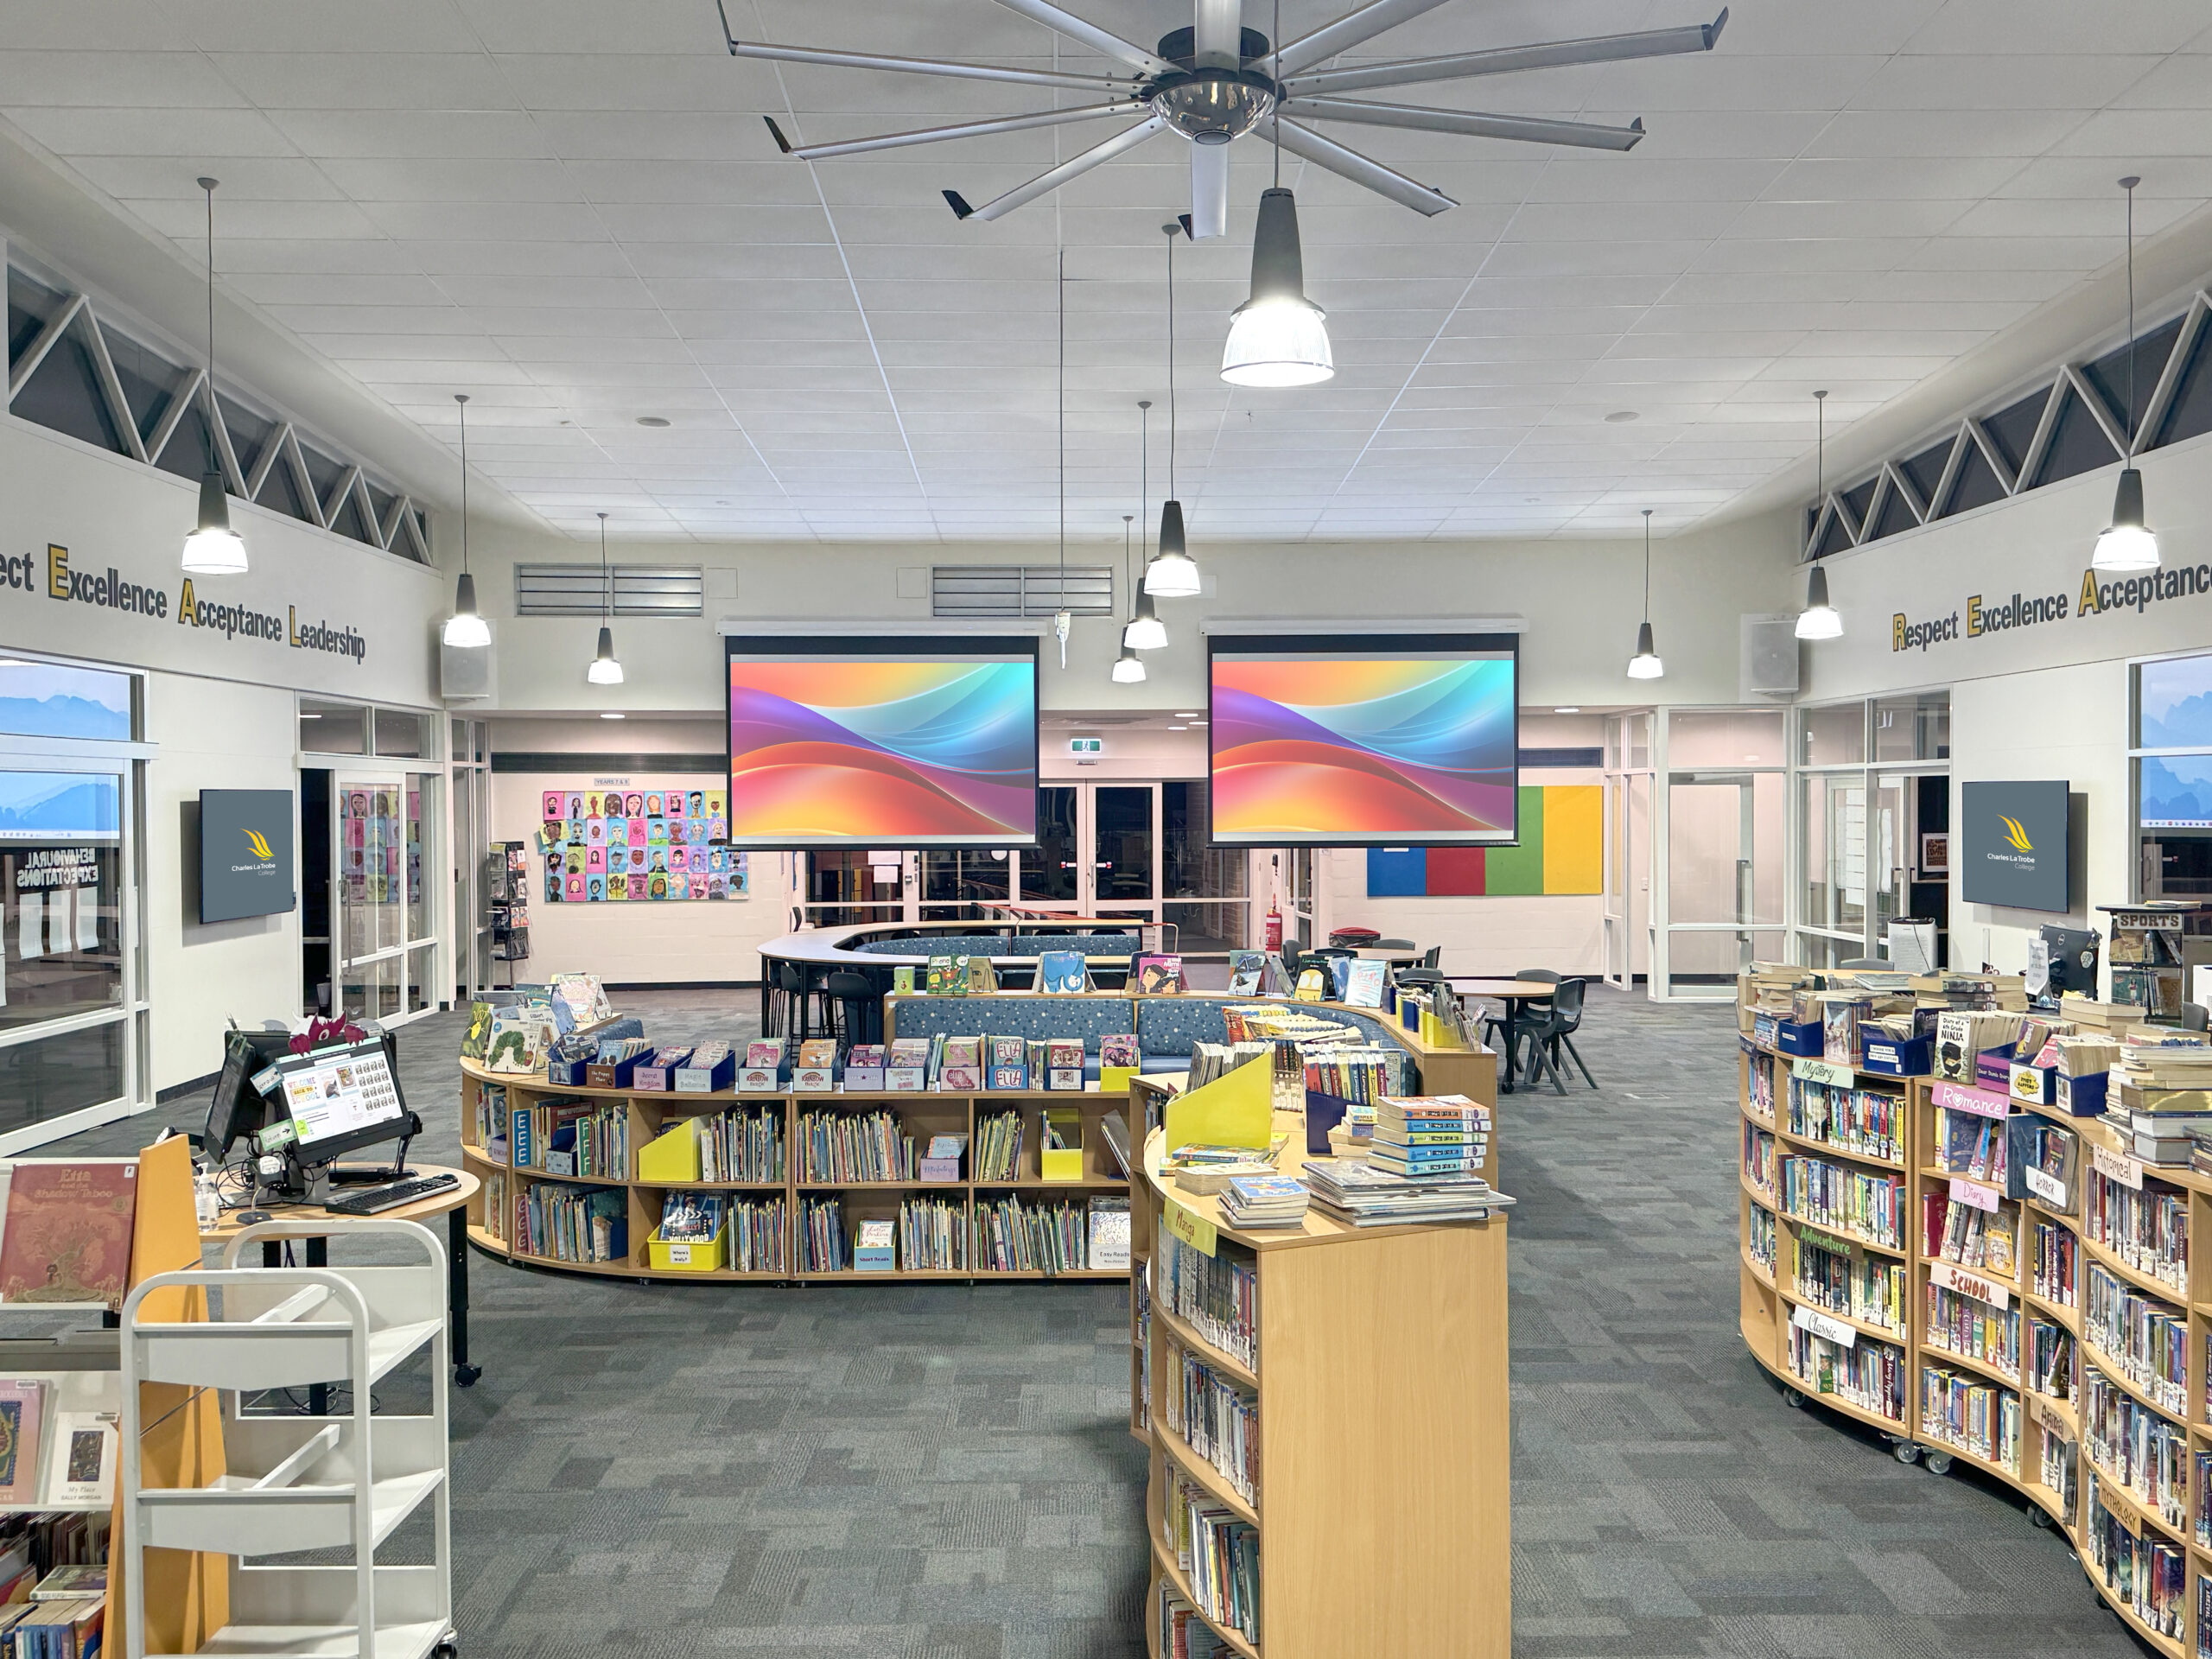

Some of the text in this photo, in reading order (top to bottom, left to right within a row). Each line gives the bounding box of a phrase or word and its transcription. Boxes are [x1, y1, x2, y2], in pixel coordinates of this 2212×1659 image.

[48, 543, 167, 619] Excellence
[177, 577, 282, 642] Acceptance
[289, 605, 365, 664] Leadership
[1892, 563, 2212, 652] Respect Excellence Acceptanc
[1987, 853, 2009, 861] Charles
[2120, 914, 2180, 928] SPORTS
[1941, 1029, 1964, 1042] NINJA
[287, 1077, 316, 1089] WELCOME
[1802, 1061, 1835, 1084] Mystery
[291, 1094, 321, 1105] SCHOOL
[1942, 1086, 2003, 1116] Romance
[35, 1188, 79, 1198] Shadow
[1963, 1183, 1986, 1208] Diary
[1176, 1209, 1195, 1243] Manga
[1800, 1224, 1852, 1255] Adventure
[1949, 1269, 1993, 1303] SCHOOL
[1808, 1313, 1837, 1340] Classic
[2101, 1486, 2137, 1530] MYTHOLOGY
